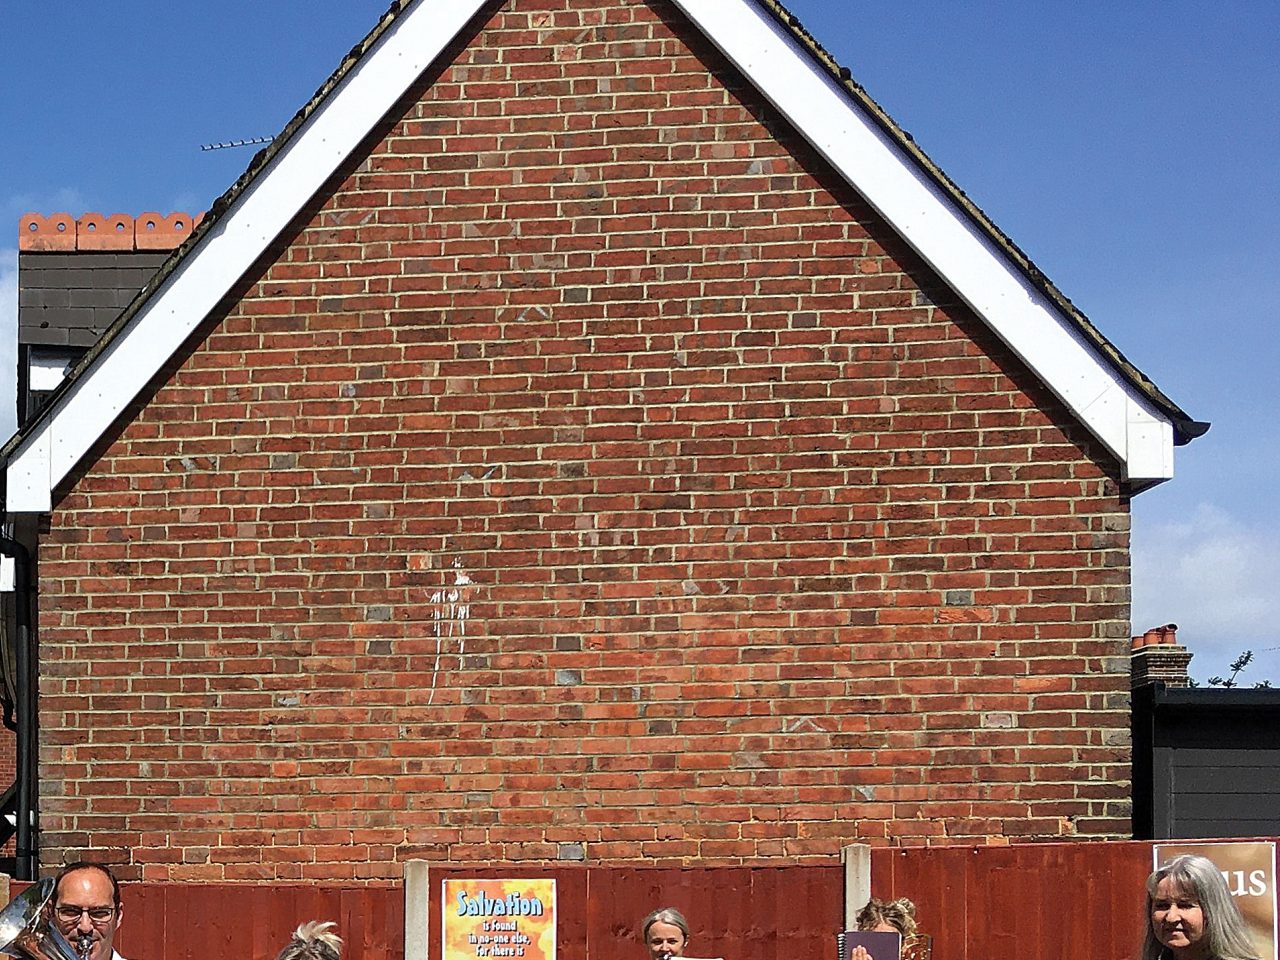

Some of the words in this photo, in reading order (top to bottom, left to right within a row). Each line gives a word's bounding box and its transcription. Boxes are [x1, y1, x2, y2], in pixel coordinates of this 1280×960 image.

[457, 890, 543, 916] Salvation
[483, 921, 491, 931] is
[492, 920, 518, 931] found
[468, 933, 478, 944] in
[479, 935, 509, 944] no-one
[511, 932, 531, 945] else,
[476, 946, 489, 957] for
[491, 945, 515, 957] there
[516, 945, 525, 956] is
